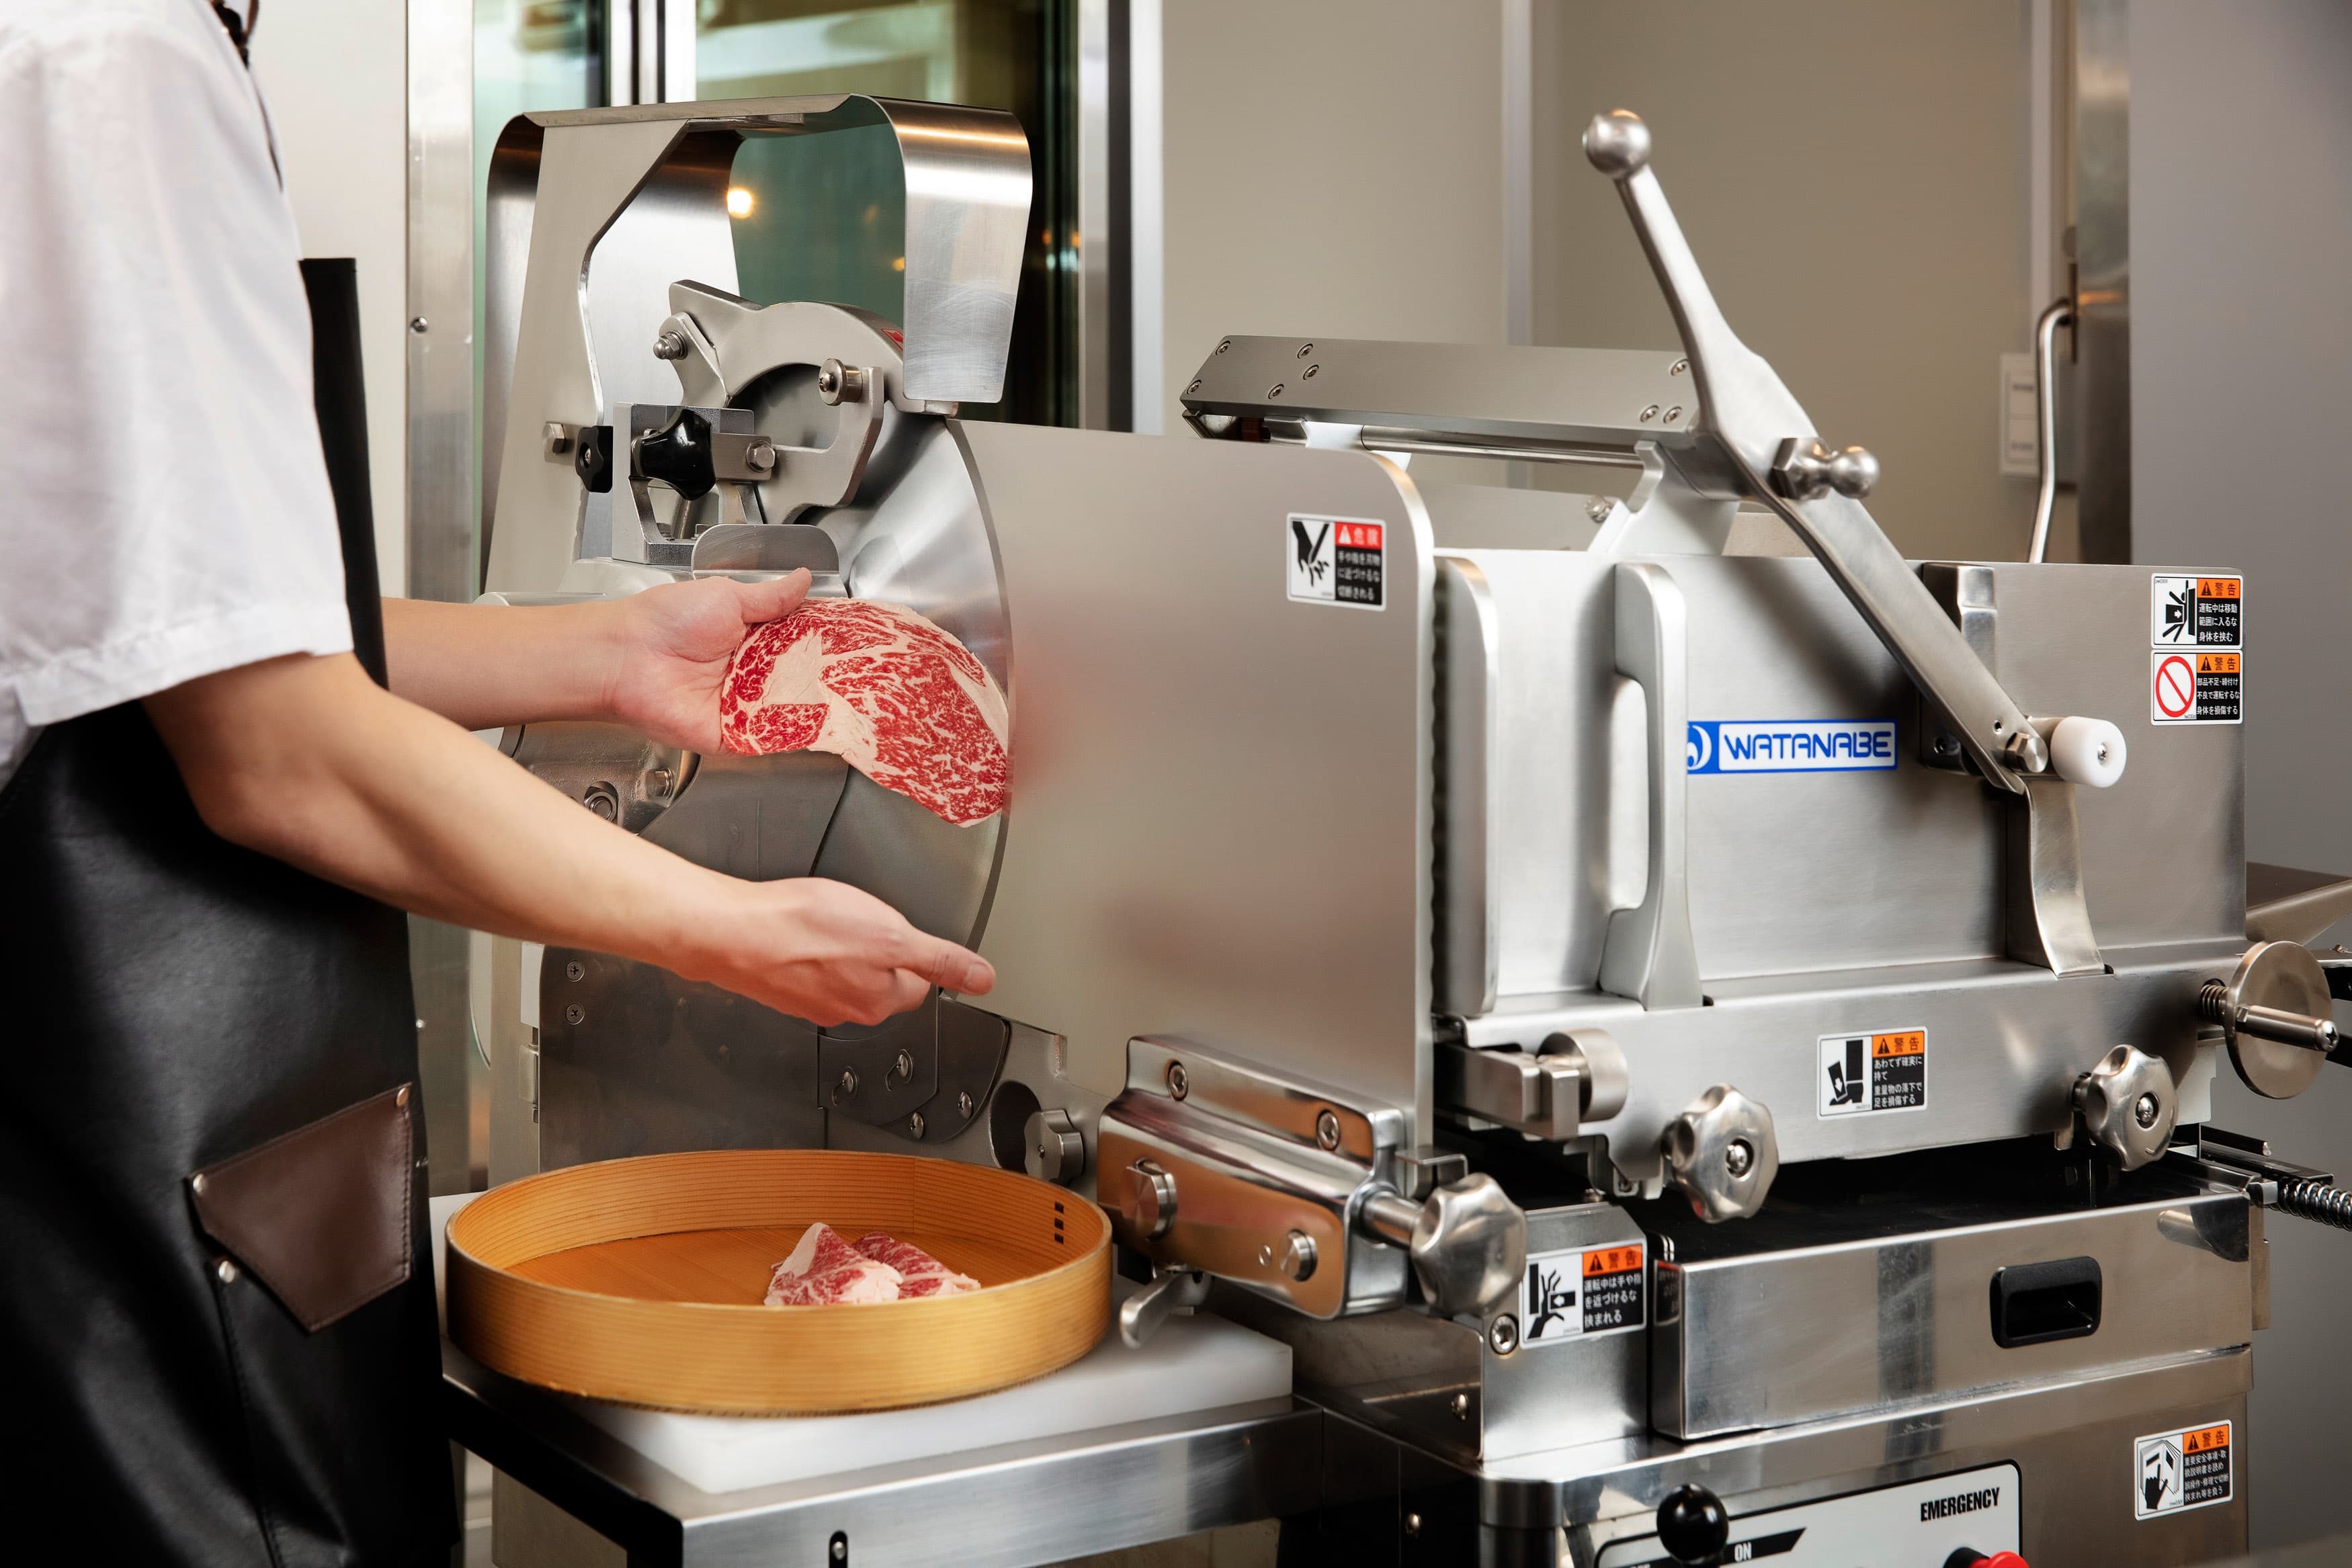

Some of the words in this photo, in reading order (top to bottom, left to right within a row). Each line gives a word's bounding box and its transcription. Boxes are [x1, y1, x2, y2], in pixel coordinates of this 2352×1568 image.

[2215, 582, 2236, 597] 警告
[2198, 603, 2238, 614] 運転中は移動
[2198, 616, 2237, 627] 範囲に入るな
[2198, 631, 2234, 642] 身体を挟む
[2214, 656, 2236, 671] 警告
[2197, 691, 2240, 700] 不良で運転するな
[2196, 705, 2238, 715] 身体を損傷する
[1724, 731, 1892, 760] WATANABE
[1894, 1037, 1920, 1053] 警告
[1874, 1055, 1923, 1070] あわてず確実に
[1874, 1070, 1888, 1083] 持て
[1584, 1272, 1642, 1293] 運転中は手や指
[1585, 1291, 1638, 1309] を近づけるな
[2201, 1429, 2226, 1448] 警告
[1920, 1487, 2000, 1522] EMERGENCY
[1734, 1542, 1752, 1562] ON
